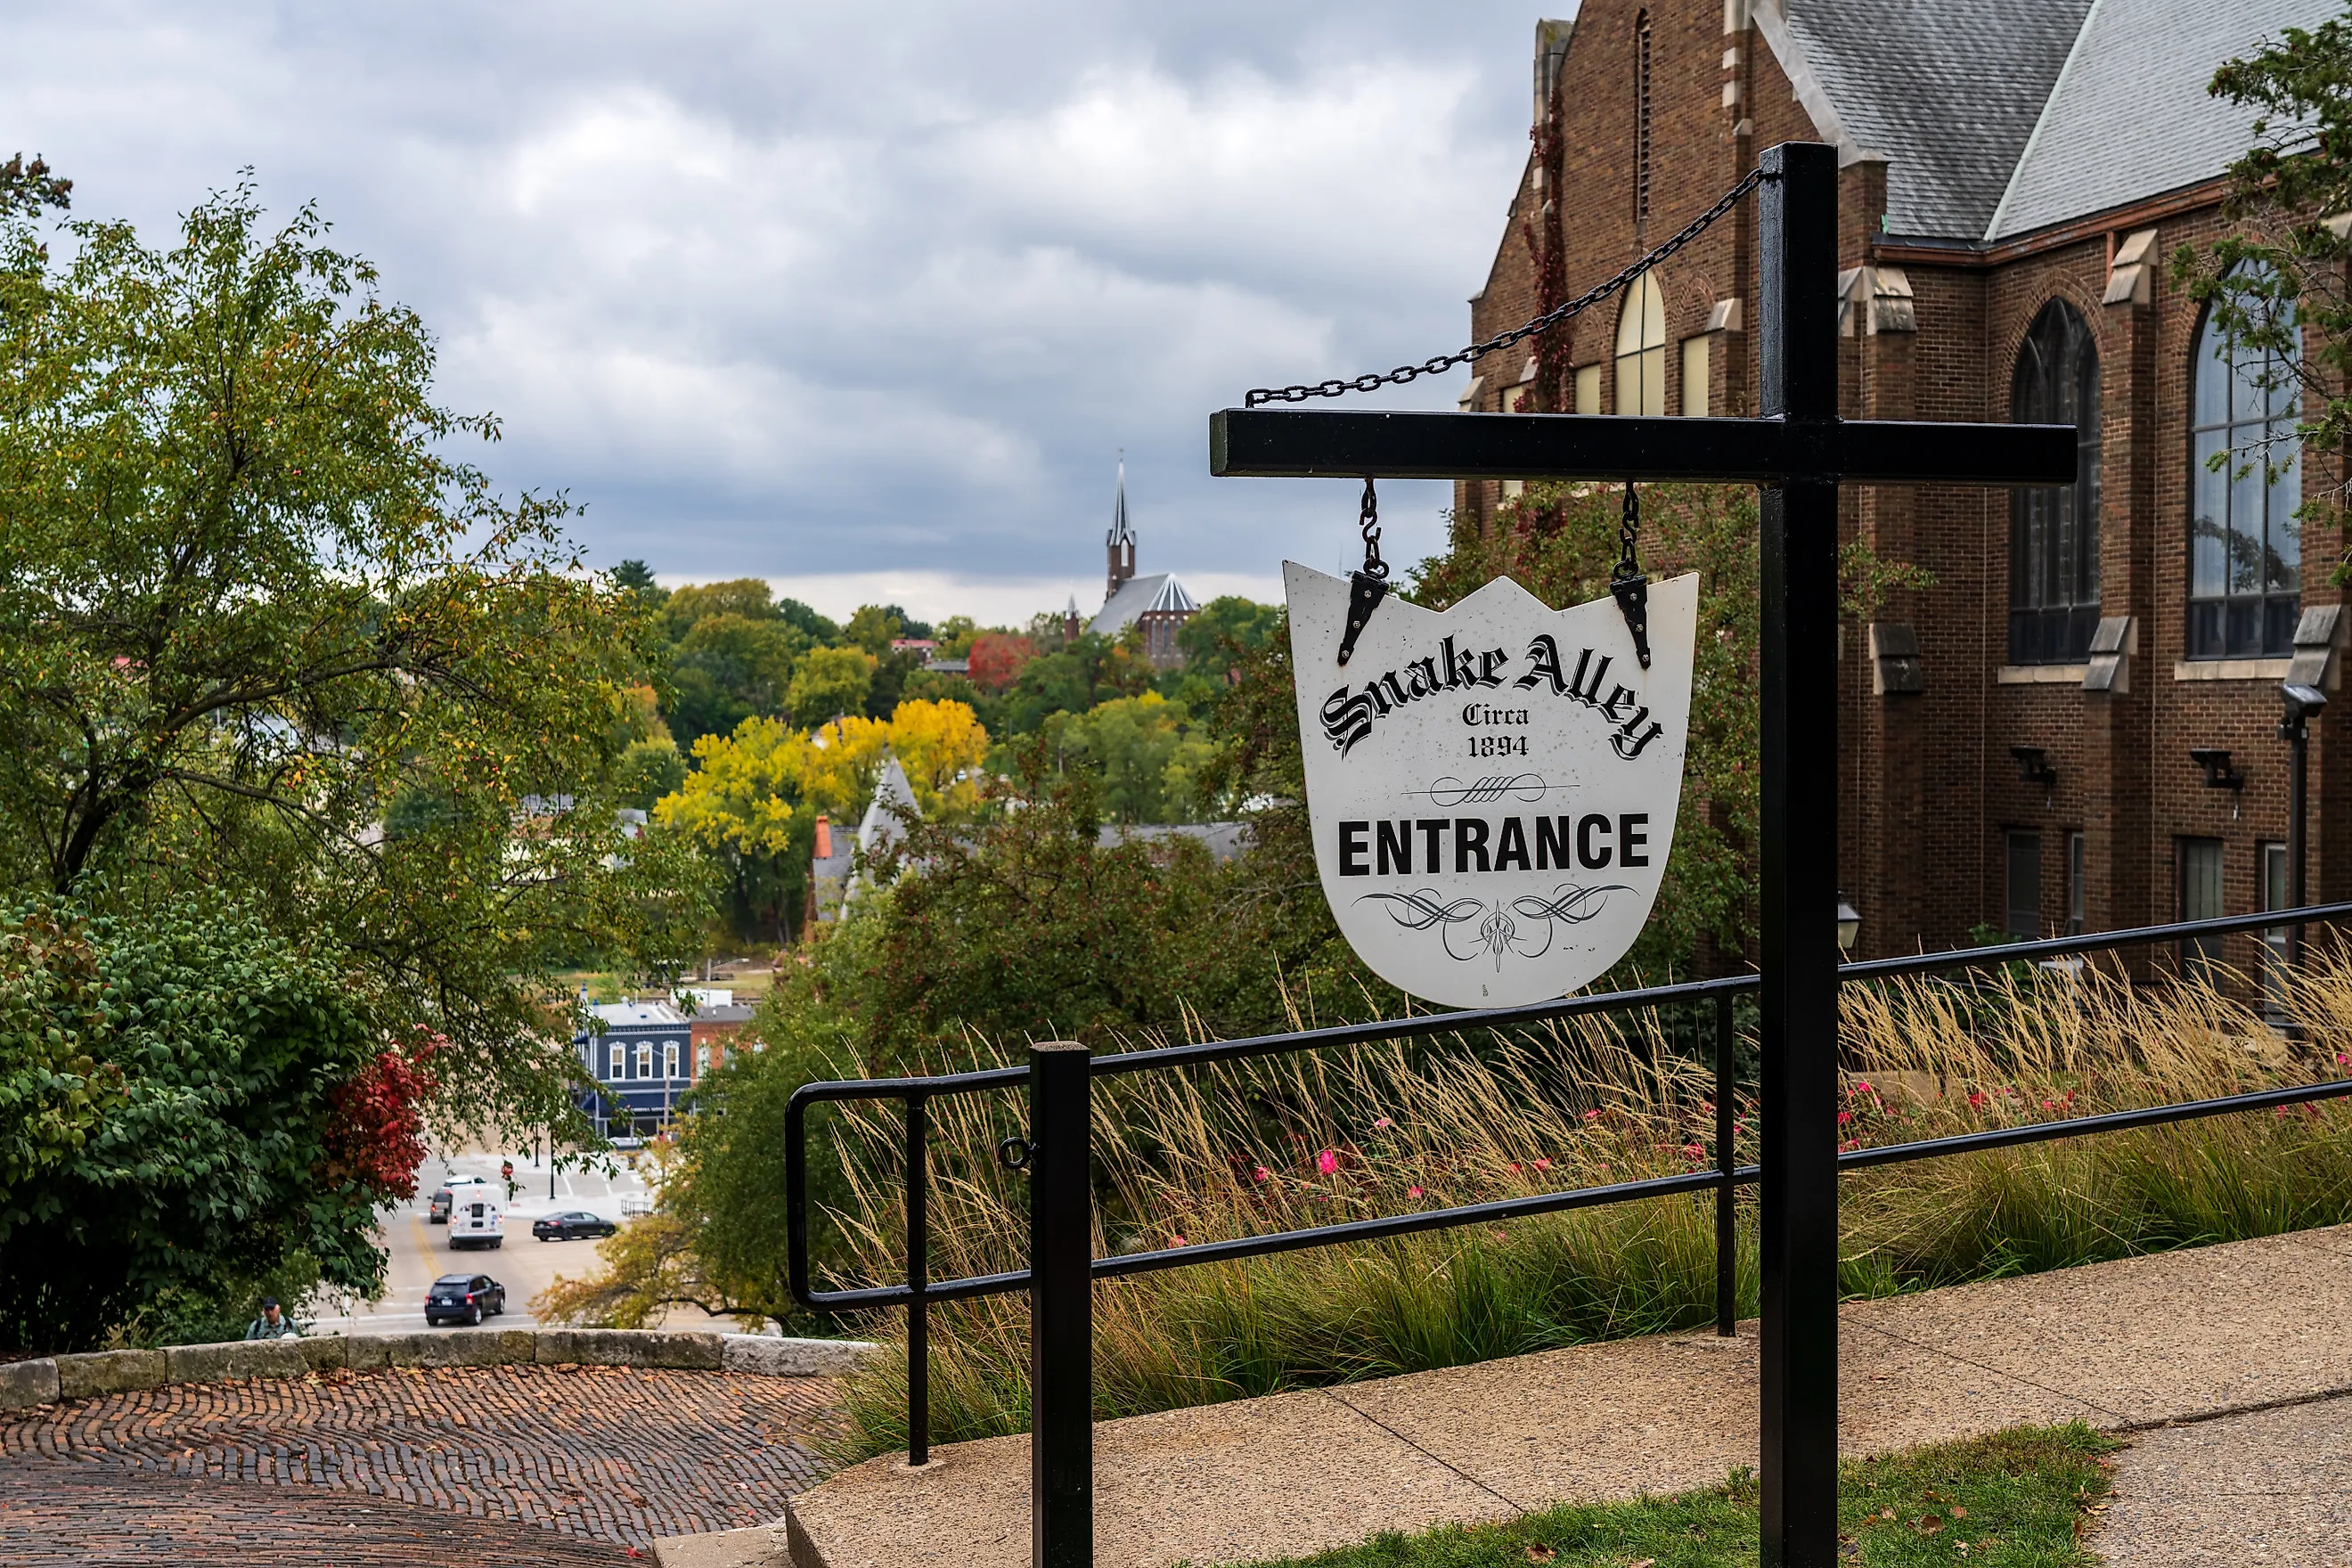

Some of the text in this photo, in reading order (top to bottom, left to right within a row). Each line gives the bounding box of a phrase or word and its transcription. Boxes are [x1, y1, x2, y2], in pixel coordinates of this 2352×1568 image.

[1319, 633, 1664, 762] Snake Alley
[1462, 702, 1530, 727] Circa
[1467, 736, 1530, 758] 1894
[1338, 813, 1649, 877] ENTRANCE
